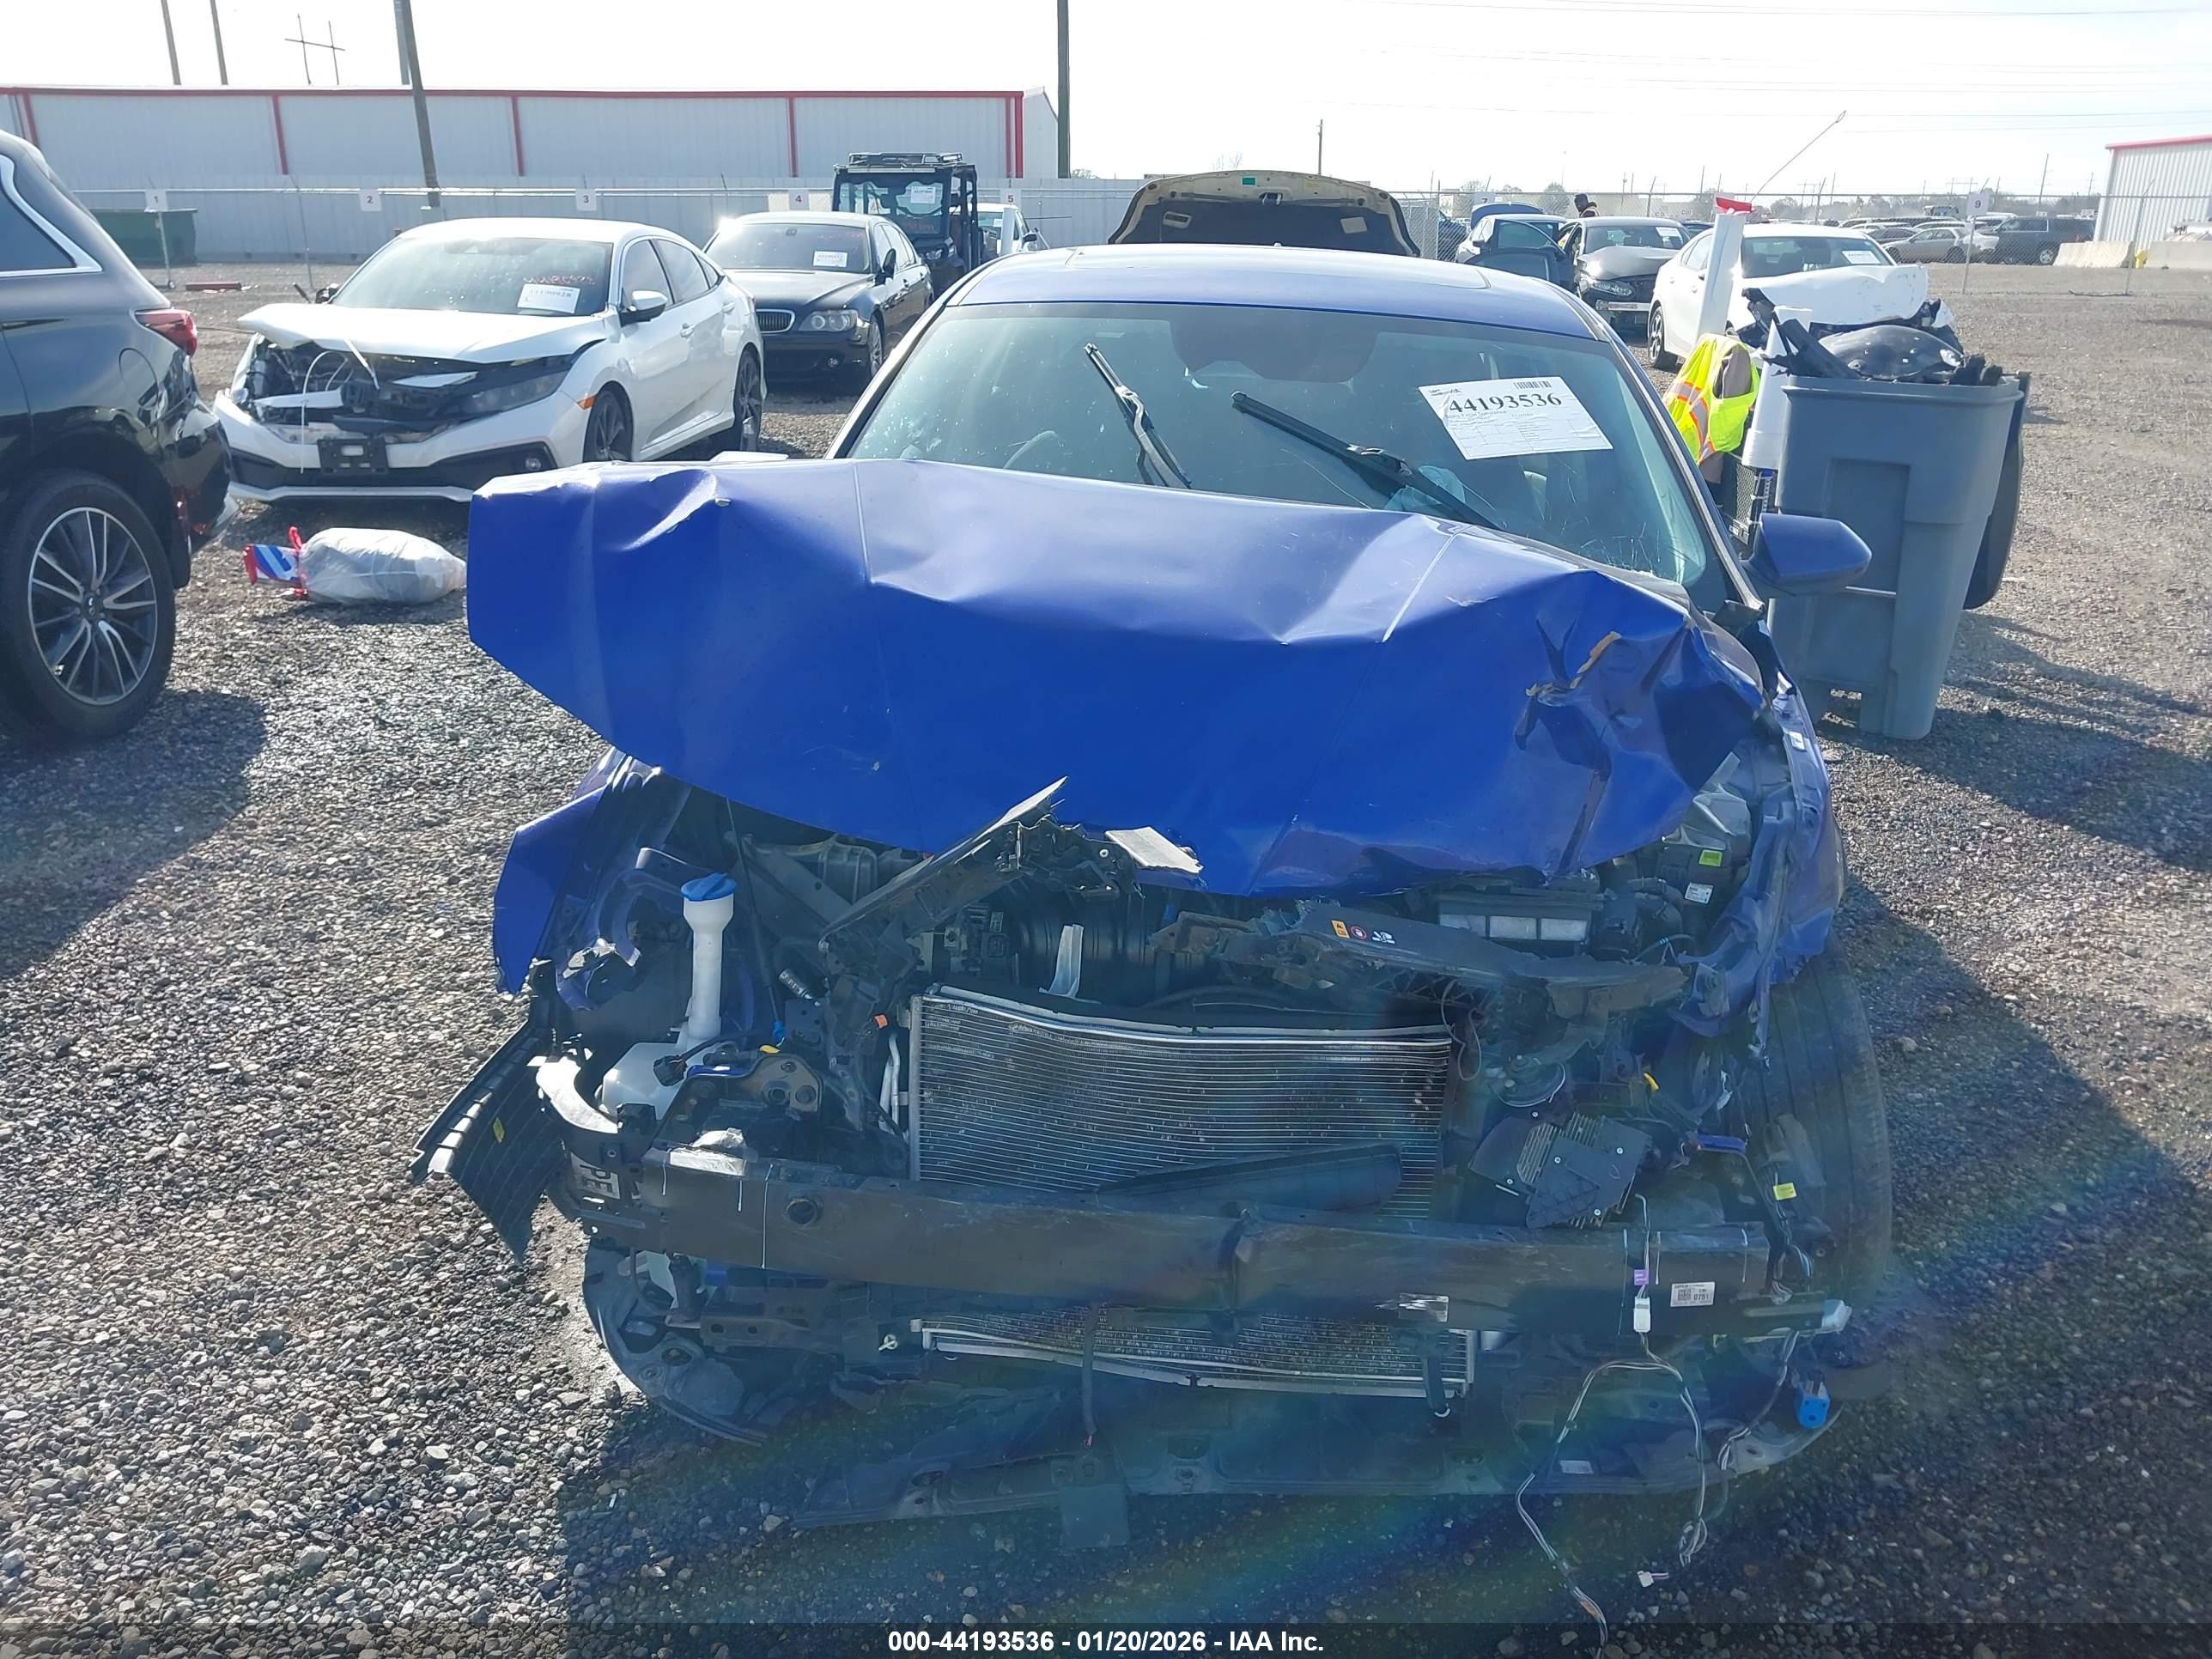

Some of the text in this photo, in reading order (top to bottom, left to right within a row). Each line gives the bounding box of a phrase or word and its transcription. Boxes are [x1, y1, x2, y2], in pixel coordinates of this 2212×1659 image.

[366, 195, 374, 204] 2
[582, 195, 590, 204] 3
[795, 194, 802, 203] 4
[1007, 194, 1014, 204] 5
[1974, 199, 1982, 209] 9
[1449, 392, 1563, 413] 44193536
